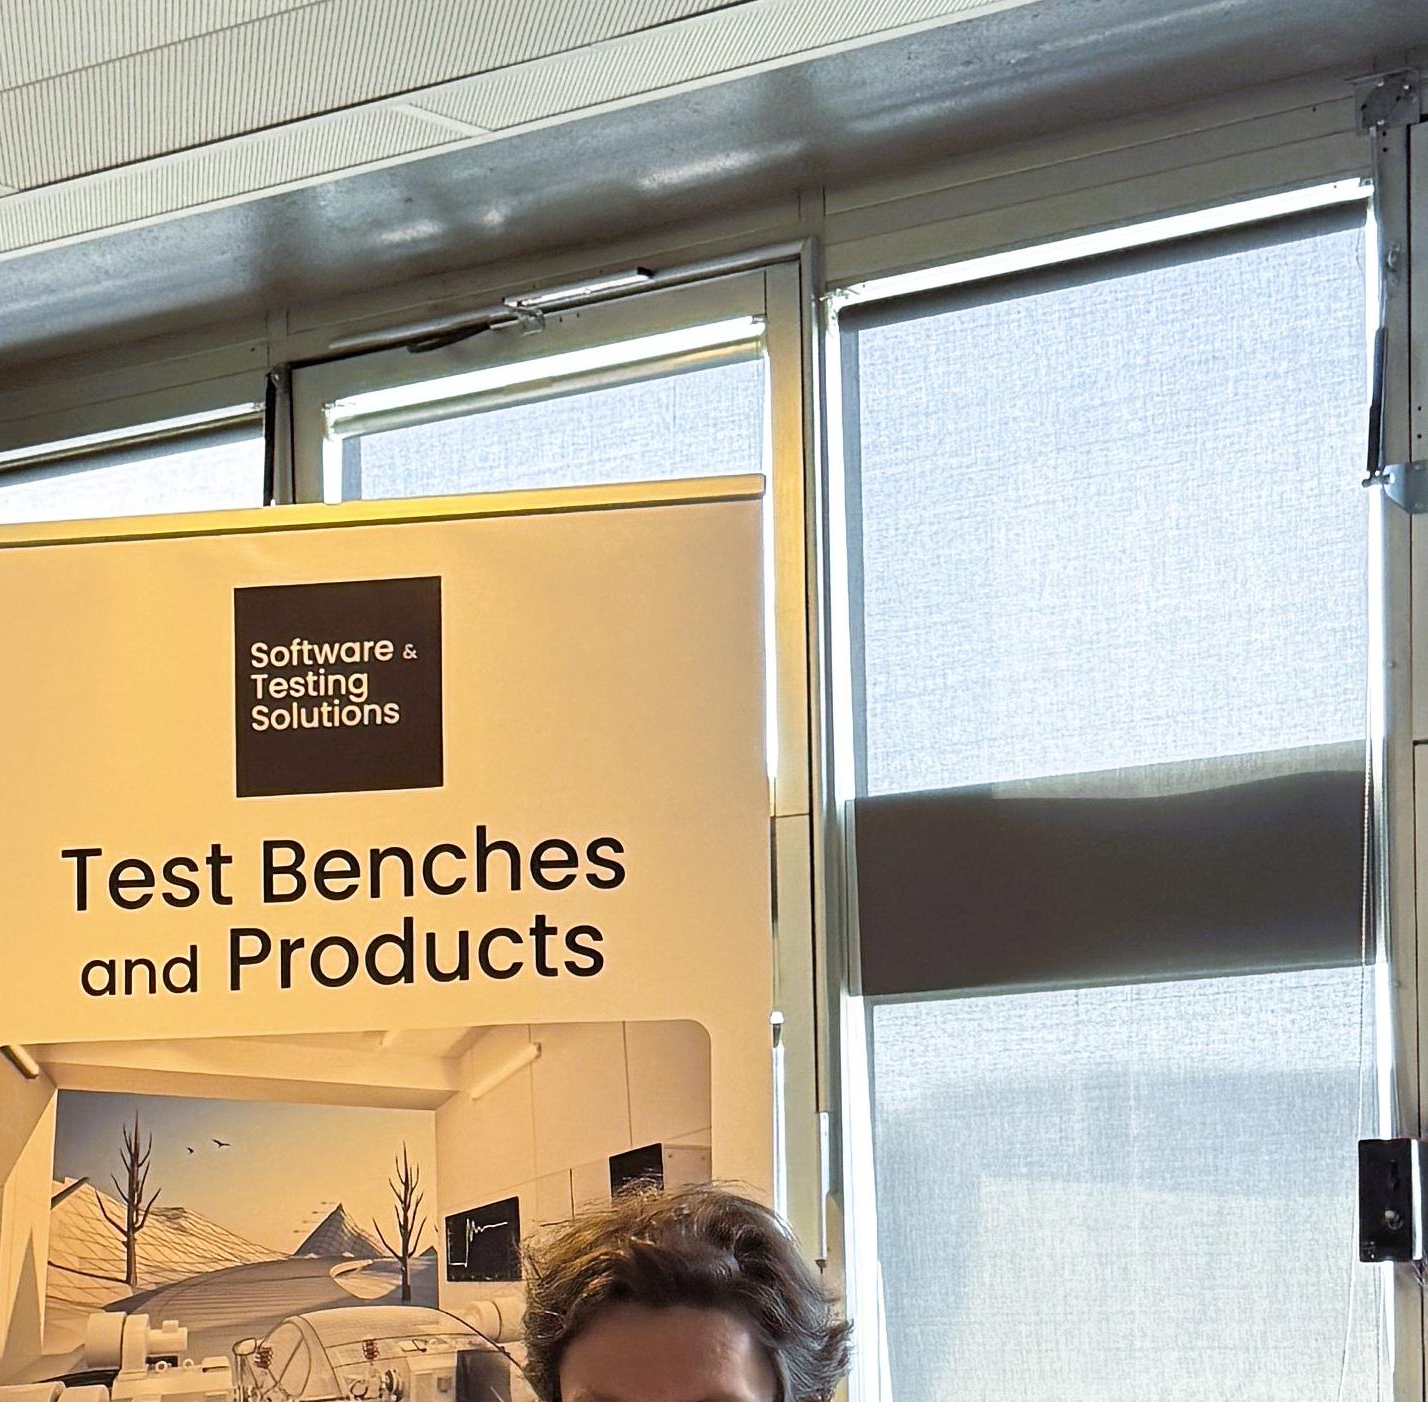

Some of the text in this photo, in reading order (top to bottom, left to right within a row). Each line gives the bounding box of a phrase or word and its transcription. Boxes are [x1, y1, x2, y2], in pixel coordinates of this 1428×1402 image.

[250, 638, 418, 669] Software &
[250, 668, 369, 703] Testing
[251, 698, 400, 731] Solutions
[61, 824, 627, 912] Test Benches
[80, 914, 606, 998] and Products
